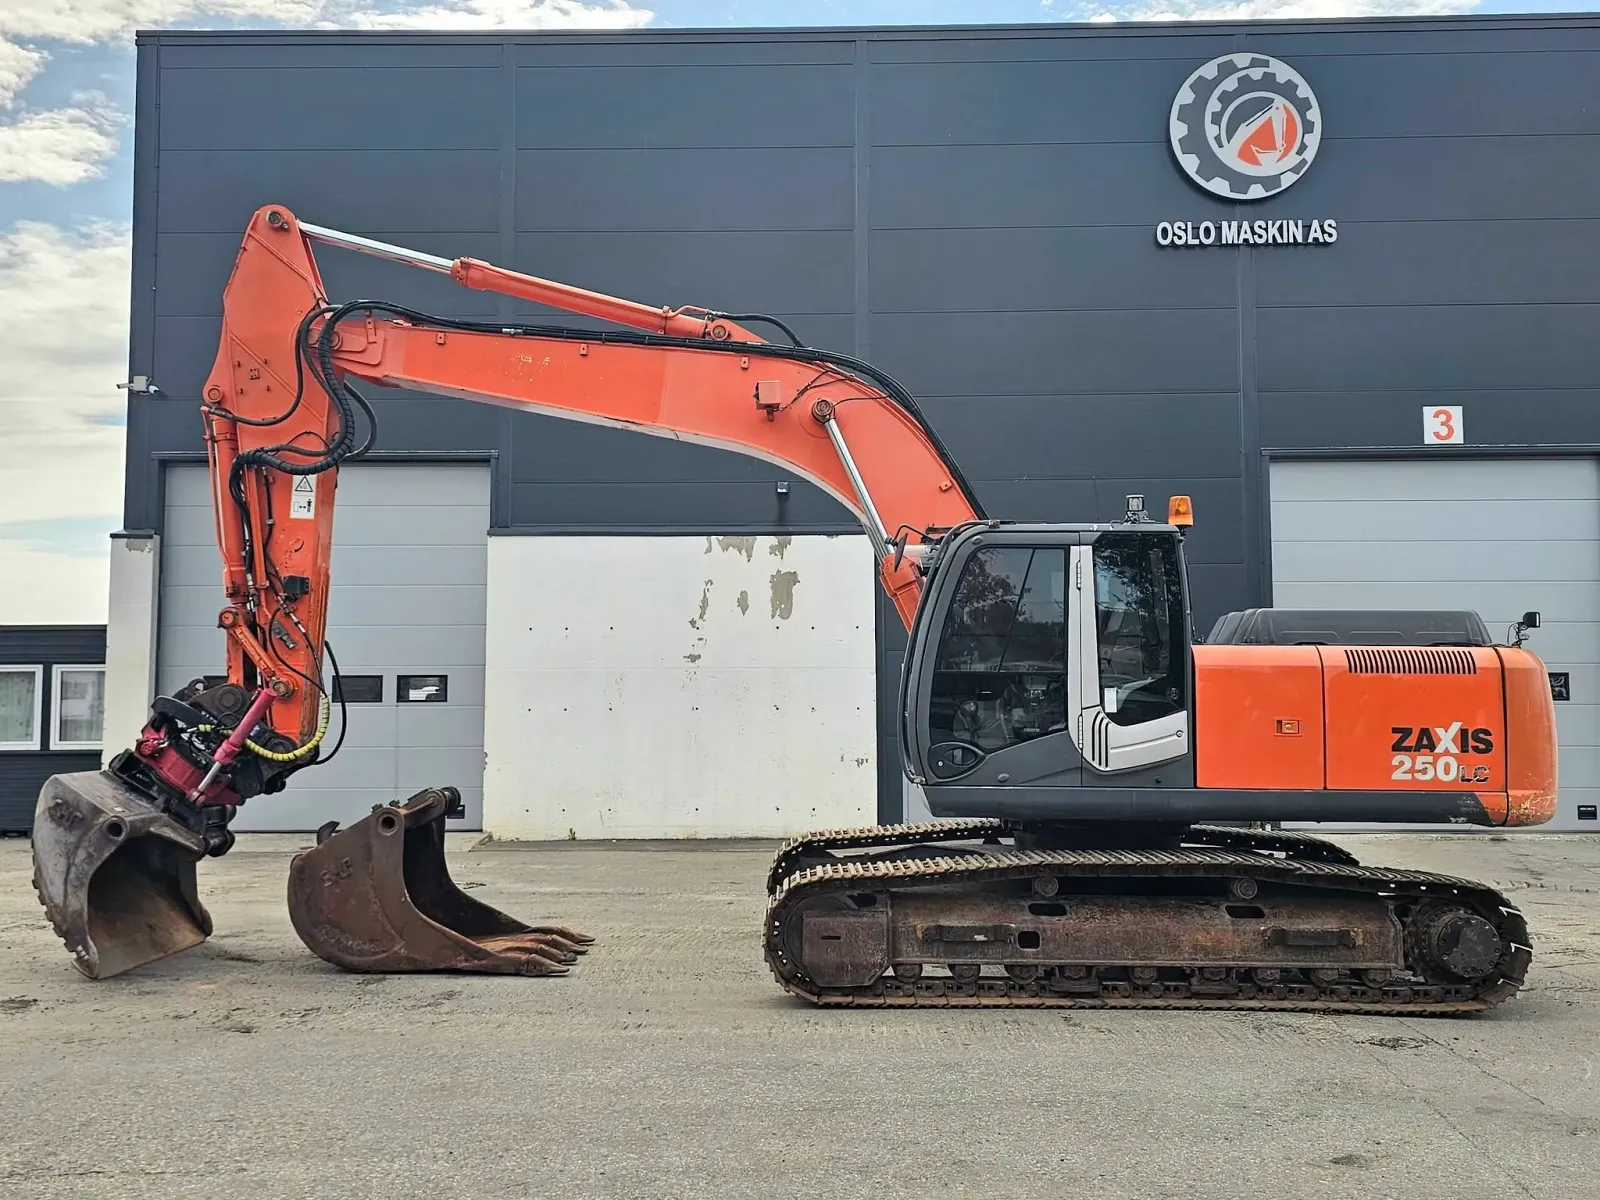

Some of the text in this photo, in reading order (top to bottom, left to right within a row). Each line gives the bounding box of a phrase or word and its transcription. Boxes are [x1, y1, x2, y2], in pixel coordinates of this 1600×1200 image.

[1156, 219, 1338, 245] OSLO MASKIN AS
[1433, 409, 1455, 441] 3
[1391, 721, 1494, 755] ZAXIS
